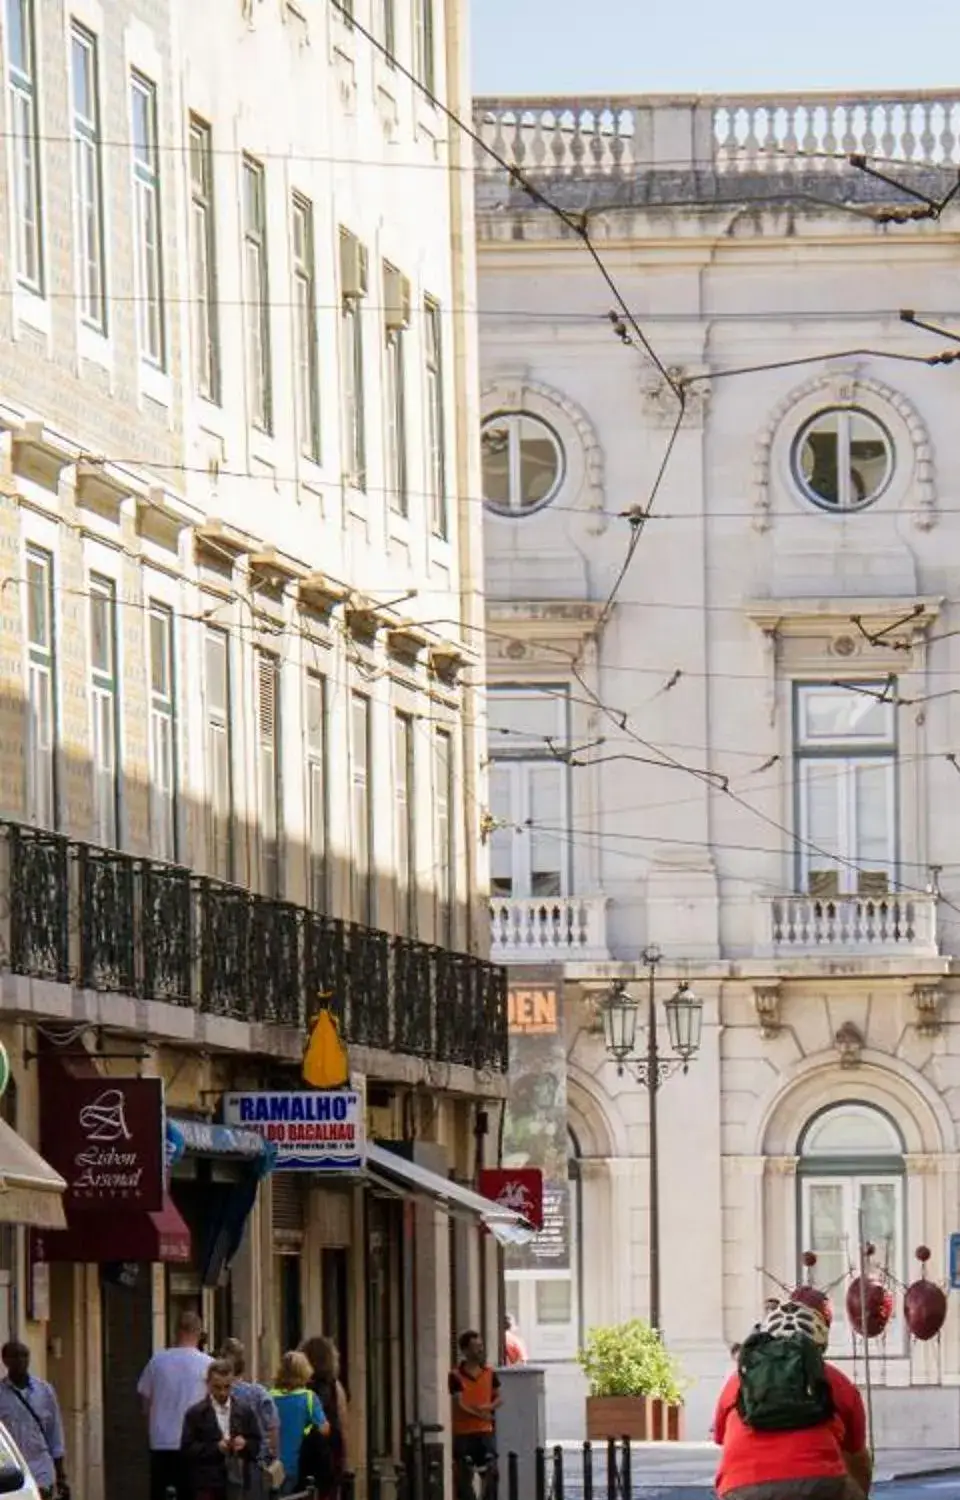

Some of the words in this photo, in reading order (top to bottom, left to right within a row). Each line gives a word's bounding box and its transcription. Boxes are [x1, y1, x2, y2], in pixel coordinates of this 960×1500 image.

[268, 1124, 285, 1141] DO
[288, 1124, 355, 1141] BACALHAU
[75, 1145, 137, 1166] Lisbon
[73, 1167, 144, 1187] Arsenal
